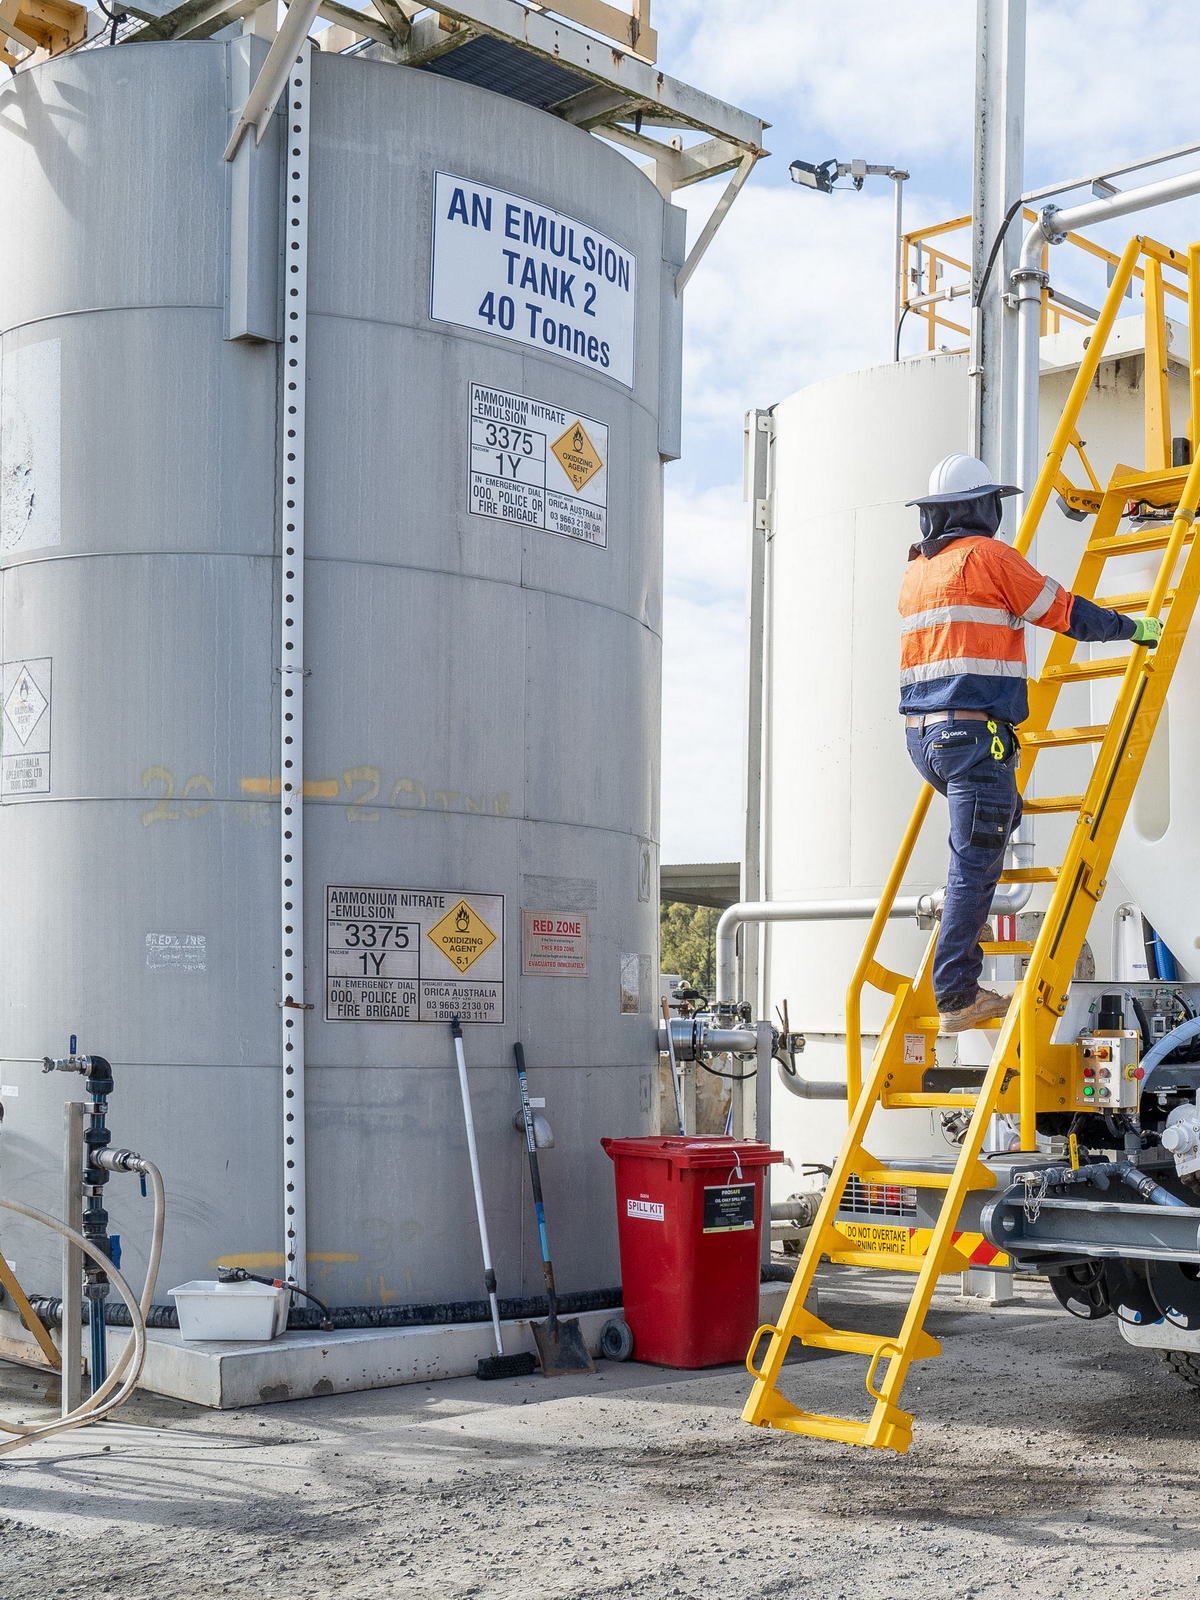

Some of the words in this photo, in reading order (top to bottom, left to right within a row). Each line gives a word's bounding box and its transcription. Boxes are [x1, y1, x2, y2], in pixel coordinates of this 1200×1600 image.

[447, 187, 492, 232] AN
[504, 203, 630, 292] EMULSION
[502, 249, 576, 308] TANK
[583, 282, 597, 317] 2
[478, 291, 515, 331] 40
[525, 302, 610, 368] Tonnes
[474, 389, 529, 414] AMMONIUM
[531, 405, 566, 425] NITRATE
[474, 403, 526, 426] -EMULSION
[485, 423, 533, 455] 3375
[495, 453, 521, 478] 1Y
[563, 452, 593, 469] OXIDIZING
[568, 462, 589, 474] AGENT
[475, 475, 483, 484] IN
[485, 478, 525, 493] EMERGENCY
[528, 488, 542, 498] DIAL
[573, 474, 583, 484] 5.1
[499, 491, 528, 508] POLICE
[532, 499, 543, 512] OR
[478, 500, 498, 515] FIRE
[502, 506, 538, 524] BRIGADE
[548, 499, 569, 511] ORICA
[569, 505, 602, 521] AUSTRALIA
[550, 511, 558, 520] 03
[559, 513, 575, 526] 9663
[576, 517, 591, 530] 2130
[592, 522, 601, 533] OR
[556, 522, 571, 534] 1800
[573, 526, 584, 538] 033
[331, 891, 397, 906] AMMONIUM
[400, 895, 445, 908] NITRATE
[331, 904, 395, 919] -EMULSION
[533, 920, 553, 932] RED
[556, 921, 581, 934] ZONE
[344, 924, 410, 949] 3375
[442, 936, 483, 945] OXIDIZING
[449, 945, 477, 953] AGENT
[359, 952, 386, 976] 1Y
[456, 956, 469, 965] 5.1
[528, 960, 556, 968] EVACUATED
[332, 980, 341, 988] IN
[345, 981, 394, 989] EMERGENCY
[424, 987, 450, 996] ORICA
[452, 988, 497, 998] AUSTRALIA
[361, 991, 397, 1004] POLICE
[402, 992, 417, 1004] OR
[426, 1001, 437, 1009] 03
[439, 1001, 460, 1010] 9663
[462, 1002, 481, 1010] 2130
[483, 1002, 495, 1010] OR
[337, 1005, 360, 1017] FIRE
[366, 1005, 410, 1018] BRIGADE
[434, 1011, 454, 1019] 1800
[457, 1011, 472, 1019] 033
[474, 1011, 488, 1019] 111
[628, 1201, 648, 1212] SPILL
[649, 1203, 663, 1214] KIT
[847, 1226, 856, 1237] DO
[858, 1227, 869, 1238] NOT
[872, 1228, 906, 1242] OVERTAKE
